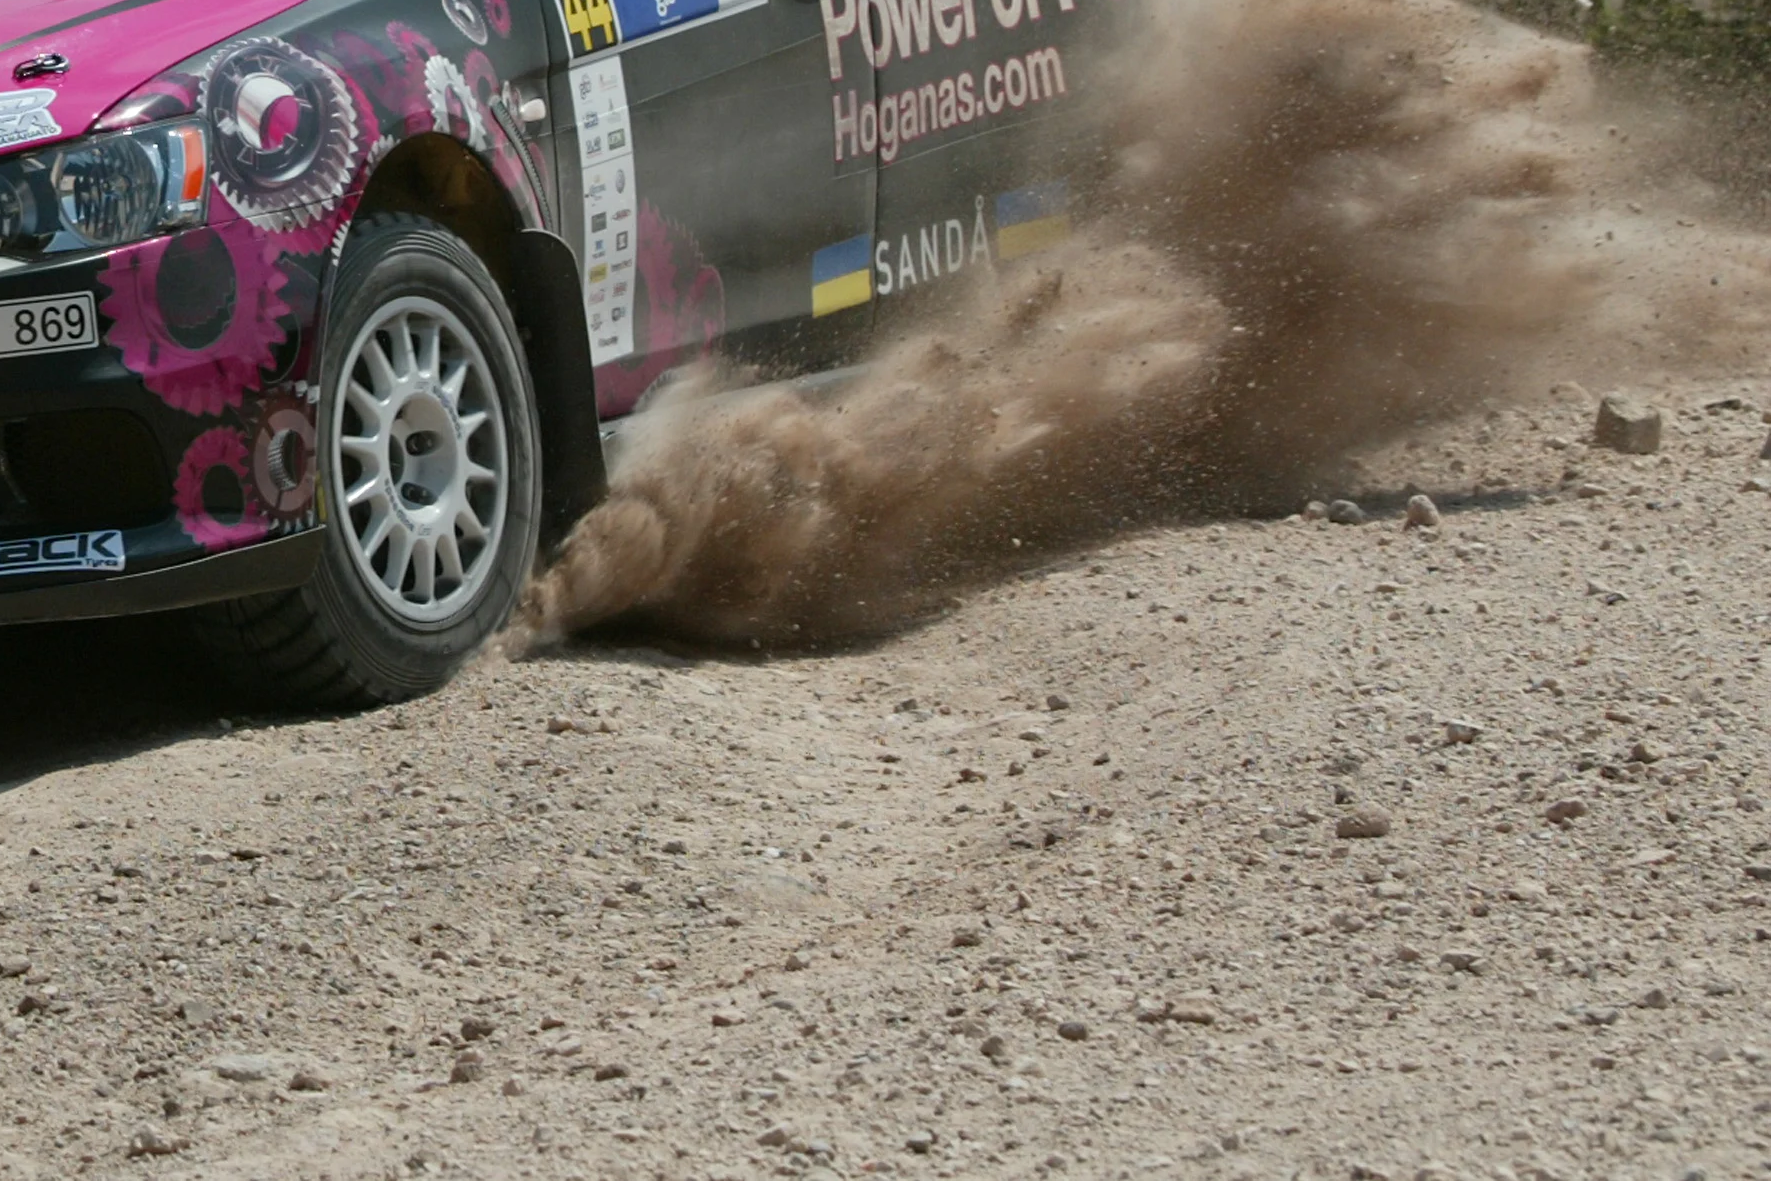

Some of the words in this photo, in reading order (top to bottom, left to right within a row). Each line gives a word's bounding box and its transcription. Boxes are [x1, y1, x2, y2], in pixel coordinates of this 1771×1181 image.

[832, 45, 1068, 163] Hoganas.com
[875, 195, 993, 296] SANDÅ
[13, 304, 86, 346] 869
[85, 557, 119, 568] Tyres
